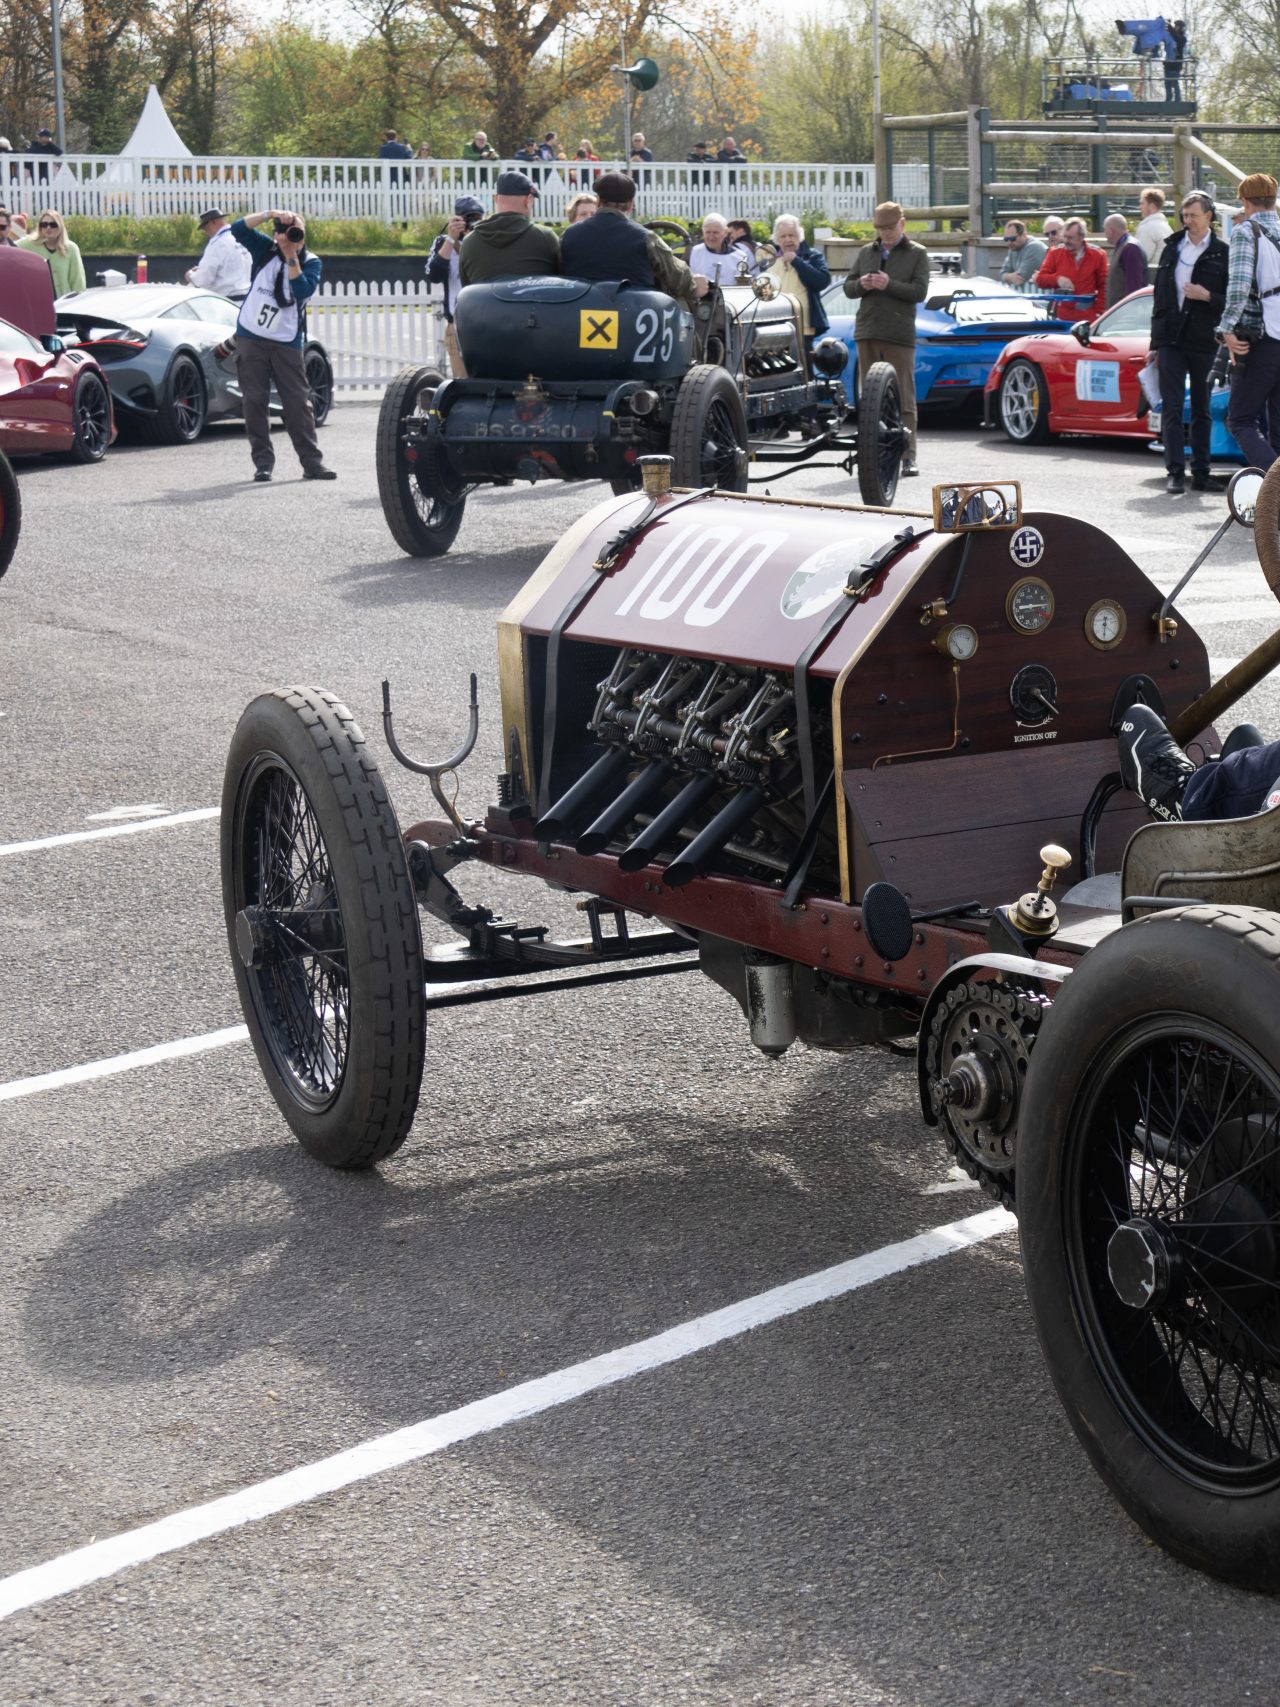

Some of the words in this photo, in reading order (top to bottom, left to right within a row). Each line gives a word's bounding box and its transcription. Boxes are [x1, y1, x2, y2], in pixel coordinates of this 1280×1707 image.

[257, 303, 280, 329] 57
[633, 306, 675, 364] 25
[613, 522, 789, 627] 100
[1013, 732, 1044, 743] IGNITION
[1044, 731, 1058, 739] OFF
